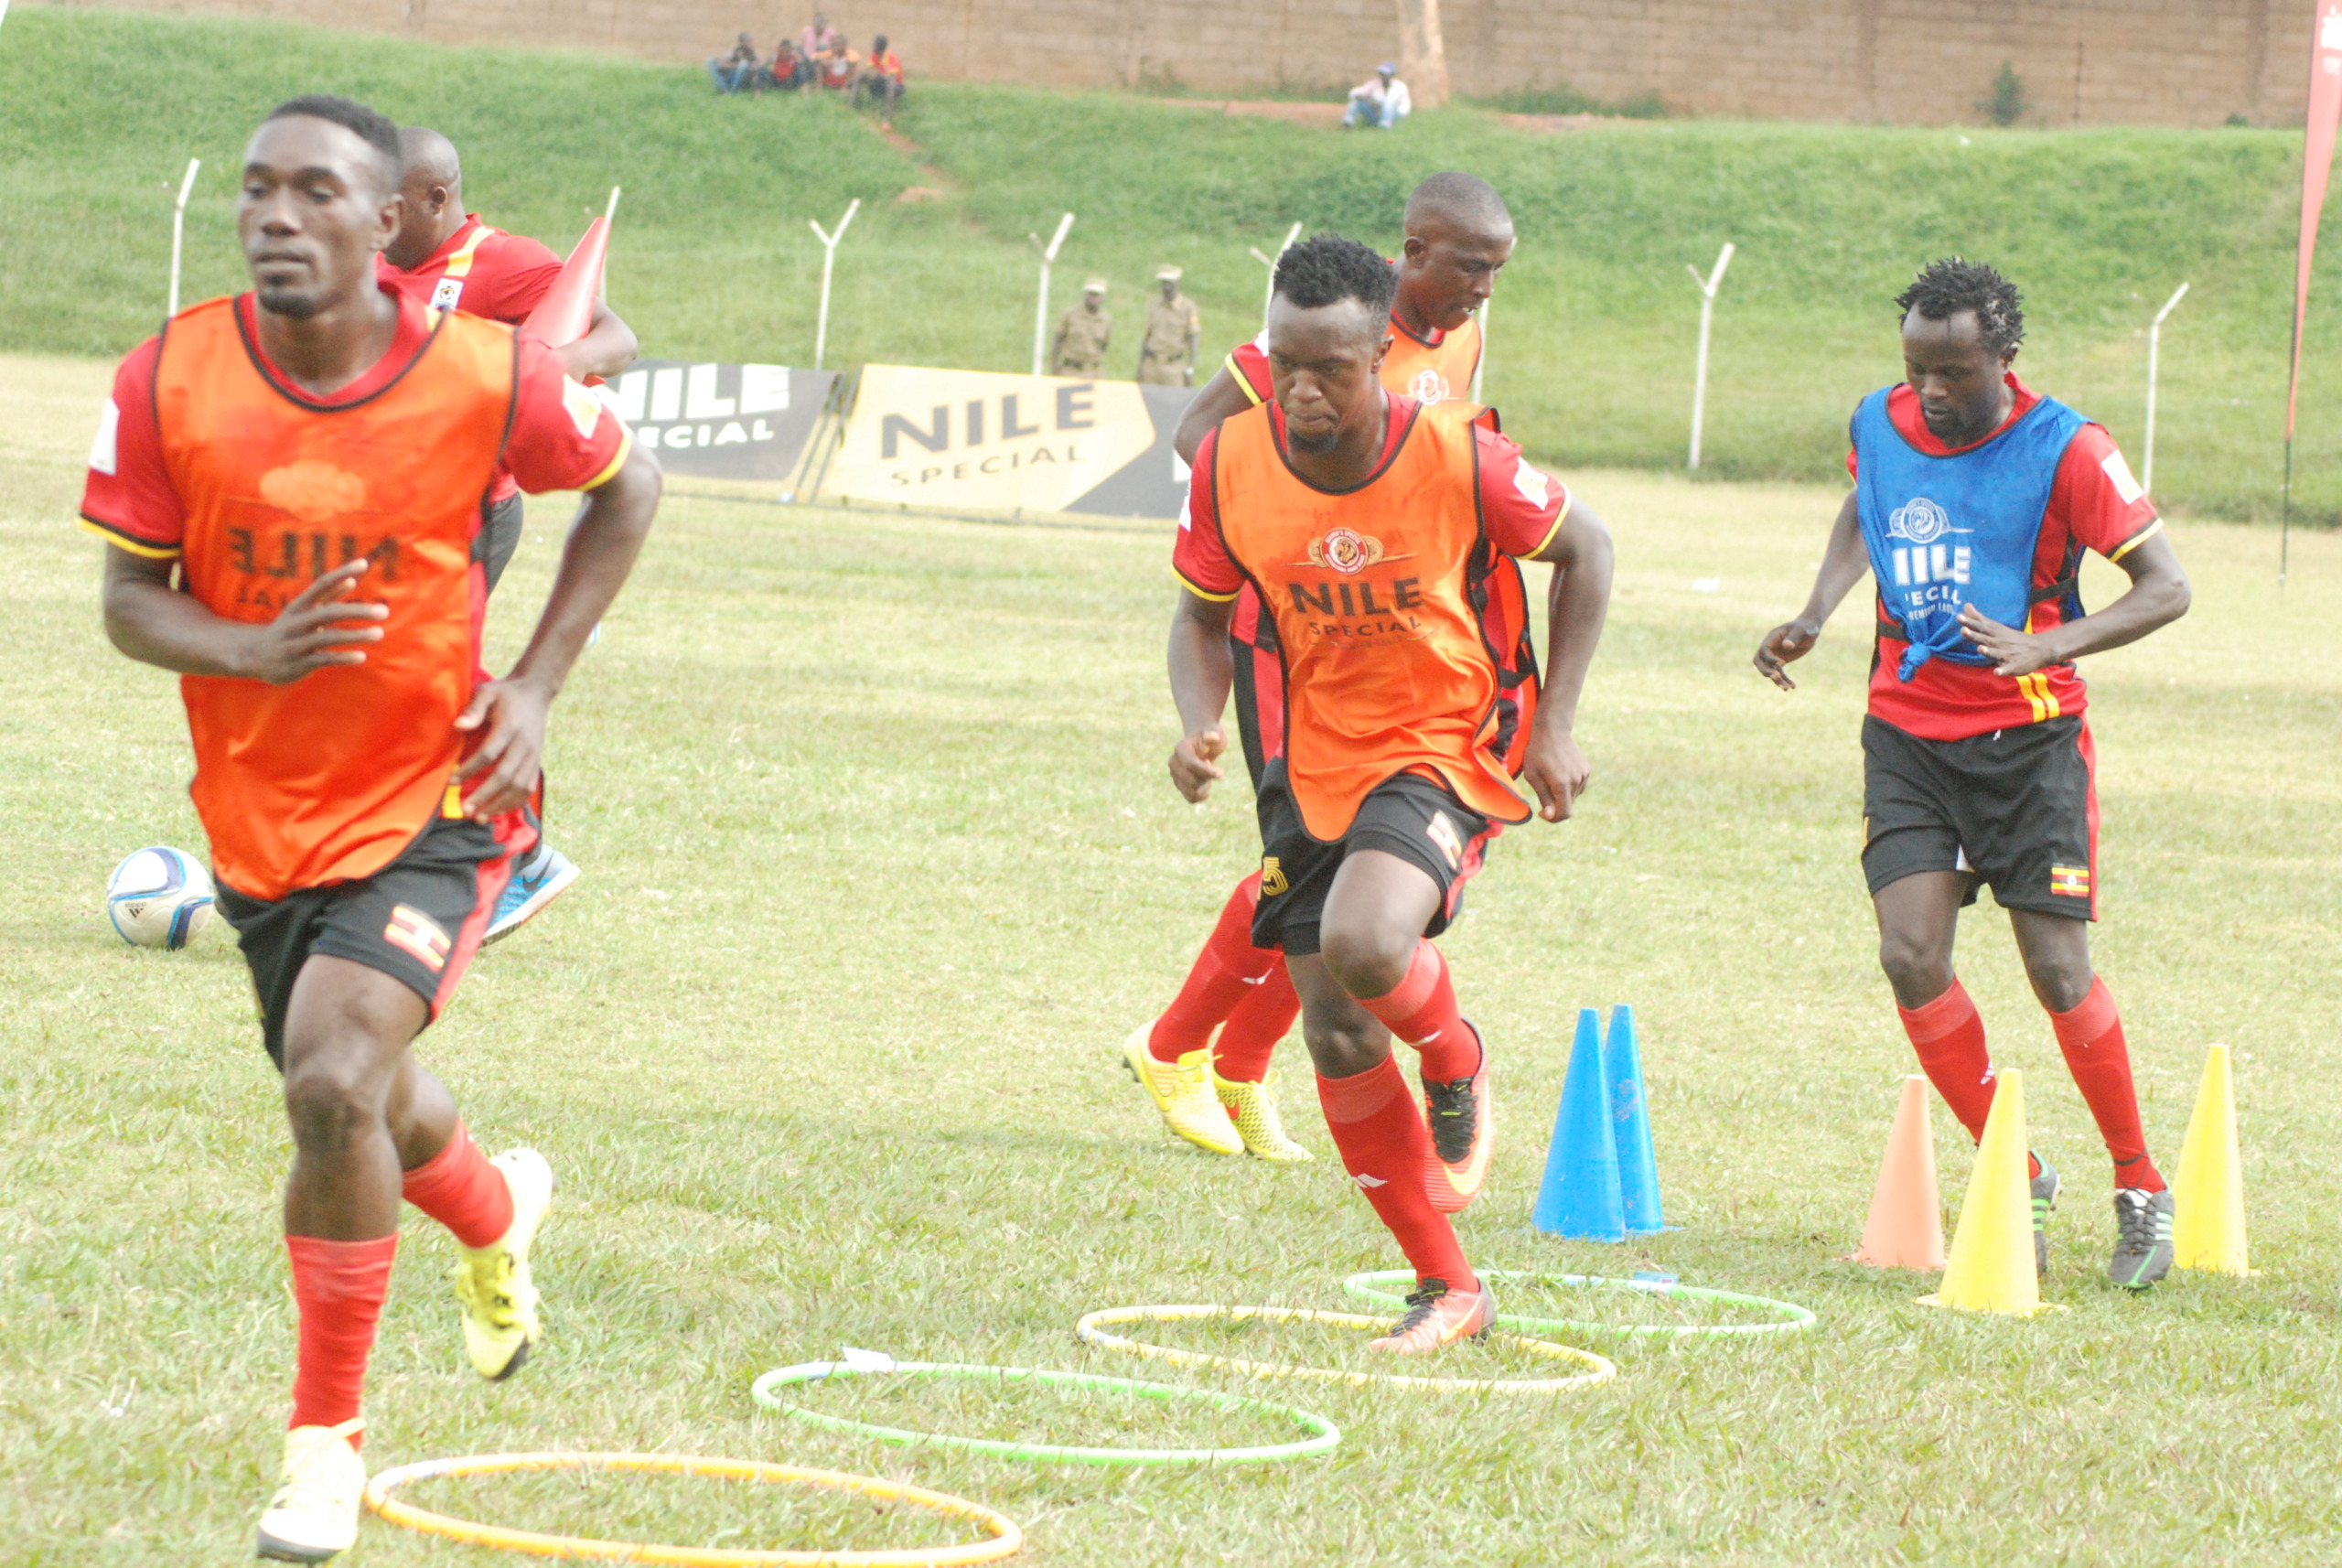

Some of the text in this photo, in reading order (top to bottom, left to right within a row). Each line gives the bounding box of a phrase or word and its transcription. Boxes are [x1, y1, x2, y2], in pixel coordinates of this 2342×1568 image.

[638, 419, 774, 449] ECIAL
[881, 381, 1094, 459] NILE
[891, 445, 1080, 488] SPECIAL
[1288, 576, 1423, 617] NILE
[1308, 616, 1422, 639] SPECIAL
[1259, 856, 1289, 899] 5
